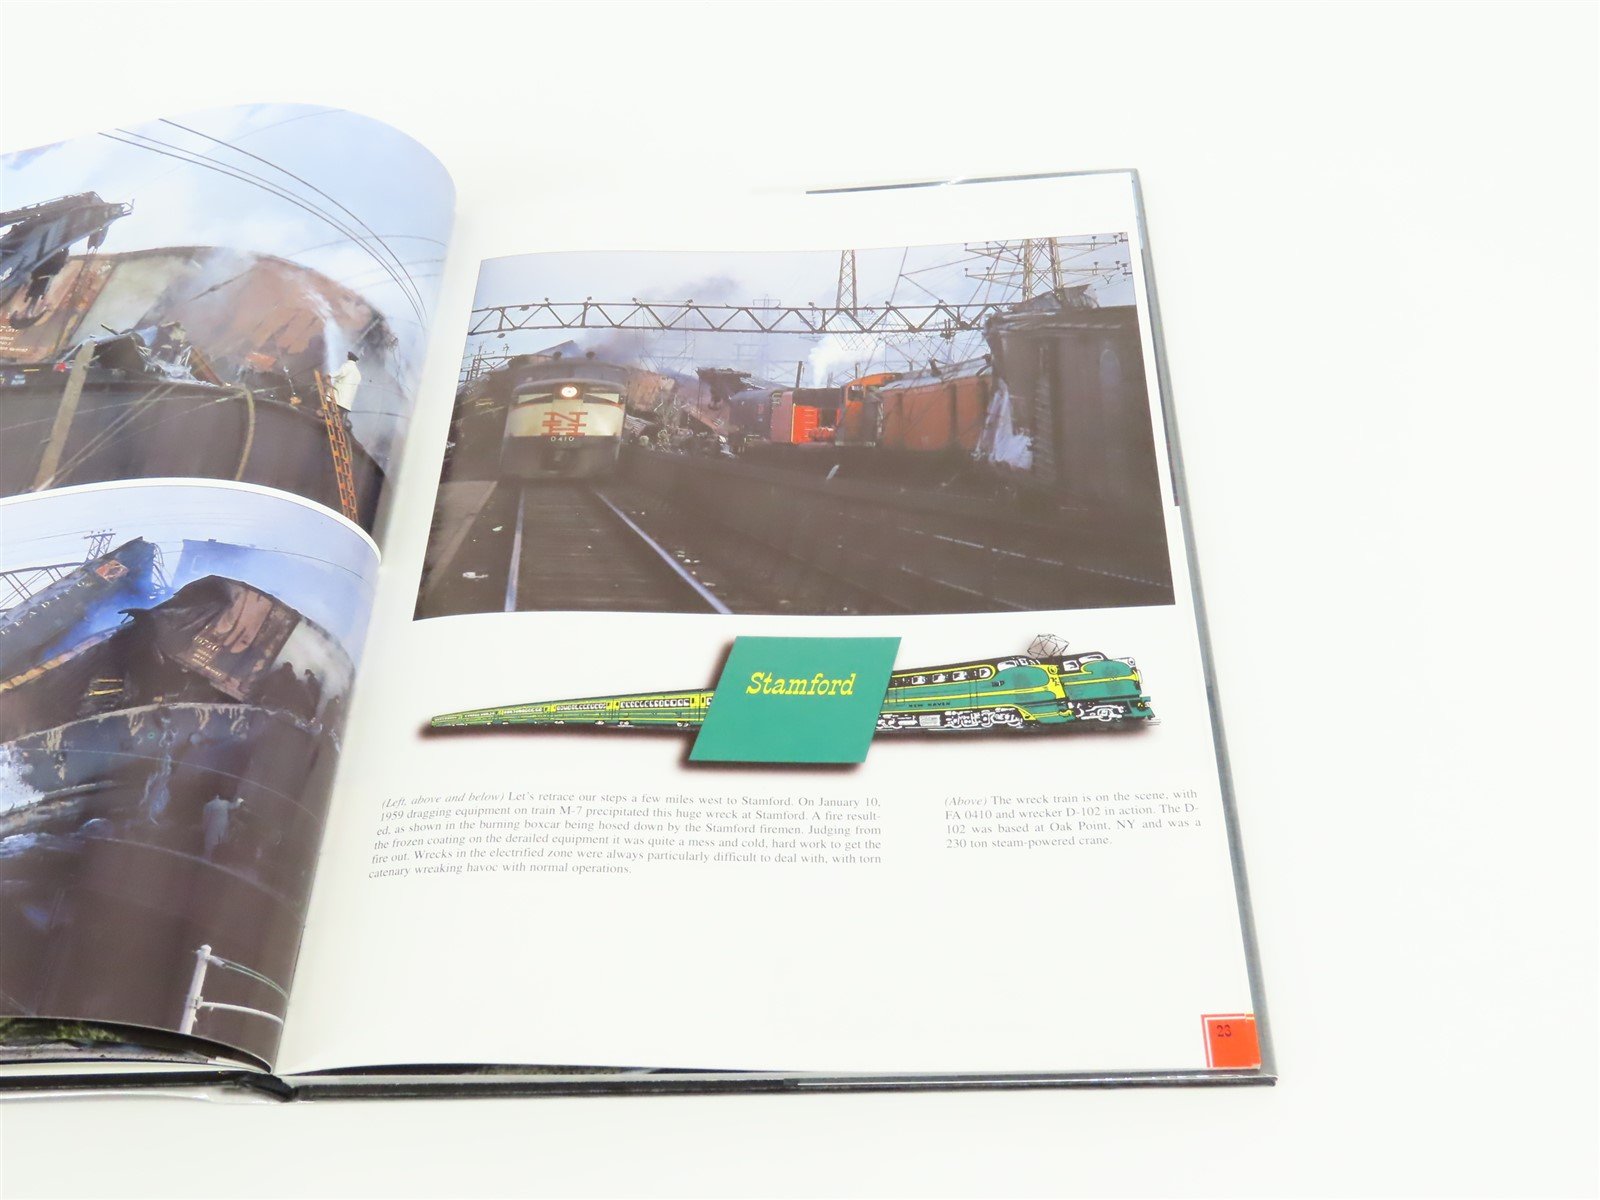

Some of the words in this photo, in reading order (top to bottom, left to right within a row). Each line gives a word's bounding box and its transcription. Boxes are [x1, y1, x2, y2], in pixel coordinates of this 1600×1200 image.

[745, 671, 858, 697] Stamford
[411, 794, 441, 805] above
[445, 792, 464, 803] and
[468, 791, 504, 803] below)
[508, 791, 534, 801] Let's
[538, 792, 575, 801] retrace
[578, 794, 596, 802] our
[600, 792, 627, 805] steps
[641, 792, 661, 803] few
[665, 793, 694, 804] miles
[698, 795, 722, 804] west
[726, 795, 737, 805] to
[798, 795, 814, 806] On
[818, 795, 860, 809] January
[944, 795, 987, 807] (Above)
[991, 794, 1012, 805] The
[1016, 793, 1049, 804] wreck
[1053, 792, 1078, 803] train
[1082, 792, 1092, 802] is
[1096, 794, 1109, 802] on
[1113, 791, 1130, 801] the
[1173, 789, 1198, 799] with
[380, 809, 404, 820] 1959
[406, 806, 452, 820] dragging
[455, 805, 511, 818] equipment
[514, 807, 528, 815] on
[531, 805, 555, 815] train
[559, 805, 583, 815] M-7
[586, 805, 649, 819] precipitated
[653, 807, 672, 817] this
[675, 807, 702, 821] huge
[705, 809, 738, 819] wreck
[742, 810, 752, 819] at
[812, 810, 820, 820] A
[825, 810, 843, 820] fire
[847, 810, 880, 821] result-
[945, 809, 960, 819] FA
[964, 808, 992, 819] 0410
[995, 807, 1015, 818] and
[1019, 807, 1062, 817] wrecker
[1066, 805, 1101, 816] D-102
[1104, 805, 1115, 815] in
[1160, 803, 1181, 814] The
[1185, 803, 1199, 813] D-
[394, 826, 405, 834] as
[408, 821, 442, 832] shown
[445, 820, 456, 830] in
[459, 819, 476, 829] the
[479, 818, 520, 831] burning
[524, 818, 560, 829] boxcar
[565, 819, 594, 832] being
[598, 819, 630, 830] hosed
[633, 821, 663, 832] down
[667, 822, 680, 835] by
[685, 822, 702, 832] the
[705, 822, 755, 833] Stamford
[808, 823, 851, 837] Judging
[855, 824, 881, 835] from
[947, 823, 966, 833] 102
[971, 825, 992, 833] was
[998, 821, 1029, 832] based
[1034, 822, 1044, 831] at
[1049, 820, 1073, 831] Oak
[1116, 819, 1135, 829] NY
[1142, 818, 1162, 828] and
[1168, 820, 1189, 828] was
[1195, 819, 1201, 827] a
[373, 840, 389, 851] the
[392, 838, 424, 848] frozen
[427, 834, 466, 846] coating
[485, 833, 502, 843] the
[505, 833, 549, 843] derailed
[552, 834, 609, 847] equipment
[612, 834, 620, 845] it
[624, 837, 644, 845] was
[647, 835, 675, 848] quite
[688, 839, 715, 847] mess
[718, 837, 738, 847] and
[772, 838, 796, 848] hard
[799, 838, 827, 849] work
[830, 839, 841, 849] to
[845, 840, 861, 852] get
[864, 839, 881, 849] the
[946, 837, 967, 848] 230
[970, 838, 988, 847] ton
[991, 835, 1075, 849] steam-powered
[371, 853, 388, 863] fire
[414, 848, 453, 860] Wrecks
[456, 848, 467, 858] in
[470, 847, 487, 857] the
[489, 847, 544, 858] electrified
[547, 850, 573, 858] zone
[577, 851, 603, 859] were
[606, 849, 644, 862] always
[647, 850, 708, 864] particularly
[713, 851, 756, 862] difficult
[760, 853, 771, 862] to
[774, 852, 796, 862] deal
[832, 853, 856, 863] with
[859, 854, 881, 864] torn
[368, 867, 411, 878] catenary
[414, 862, 463, 875] wreaking
[466, 862, 498, 872] havoc
[502, 861, 525, 872] with
[529, 862, 568, 872] normal
[1216, 1024, 1232, 1038] 23
